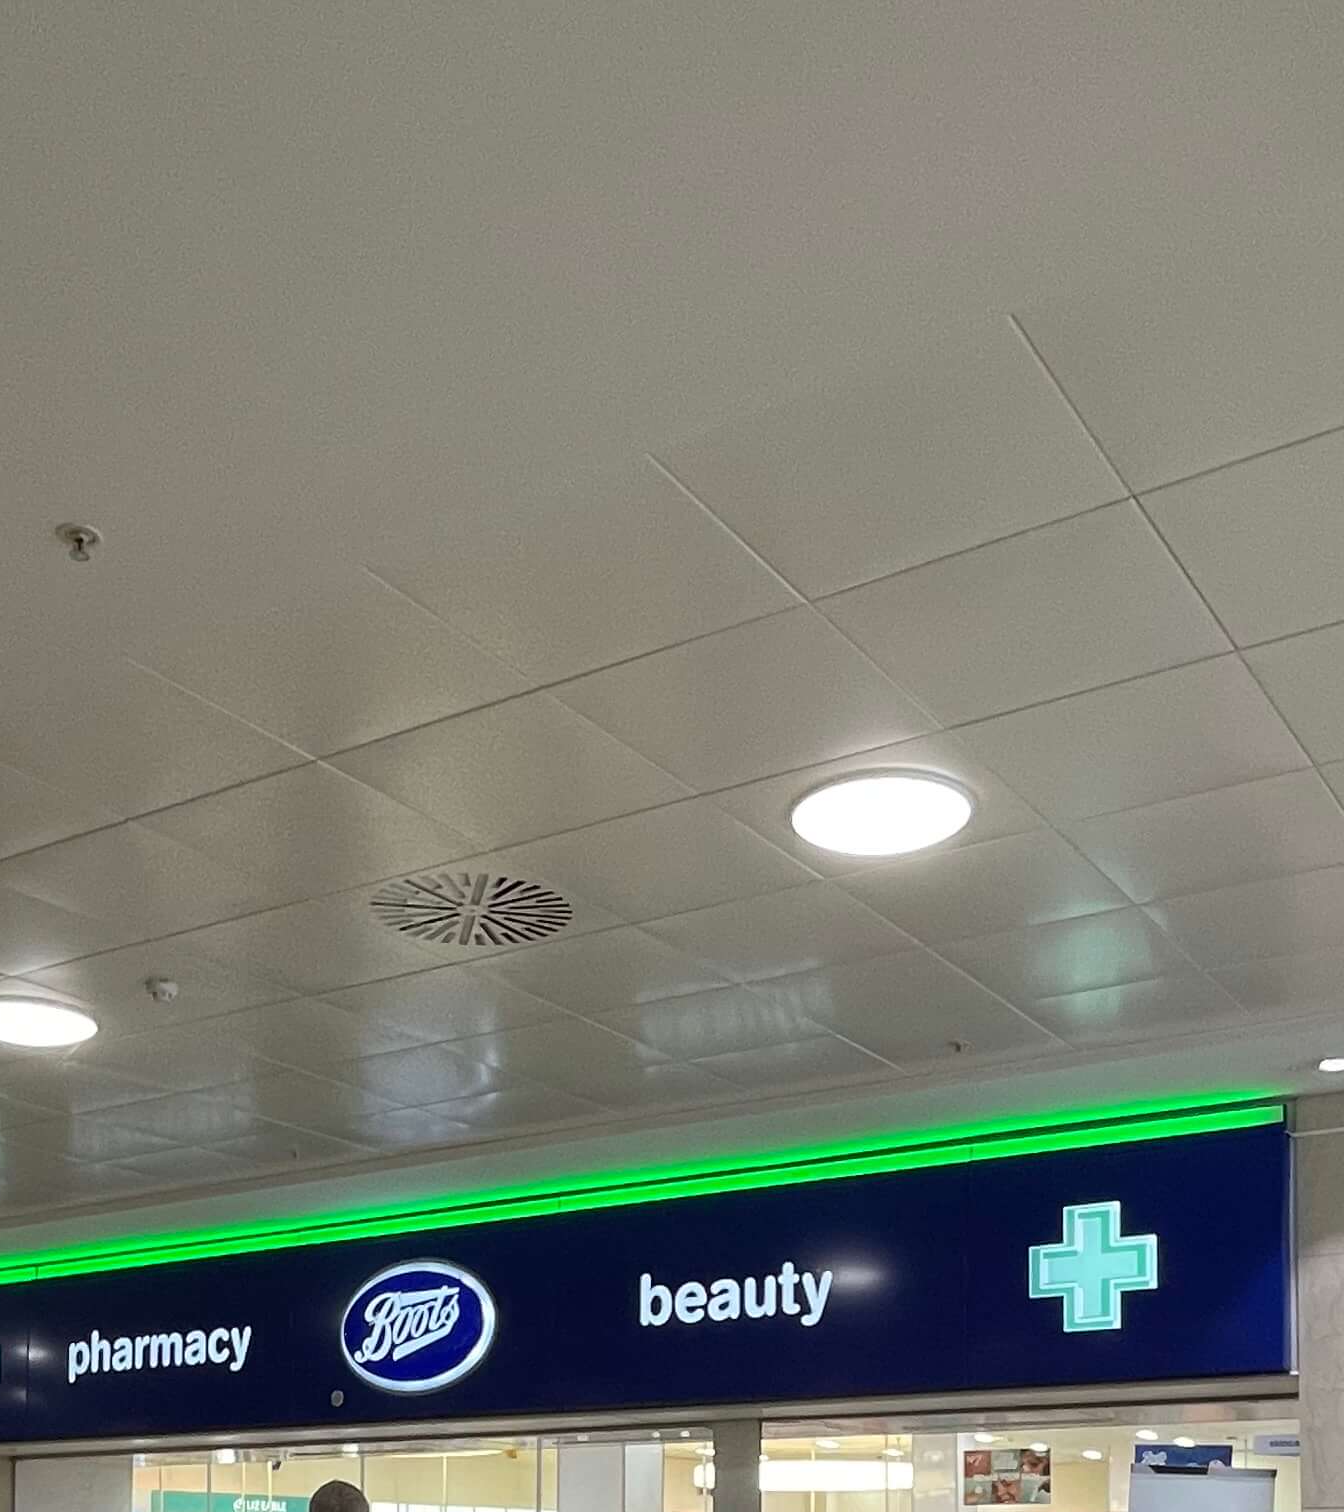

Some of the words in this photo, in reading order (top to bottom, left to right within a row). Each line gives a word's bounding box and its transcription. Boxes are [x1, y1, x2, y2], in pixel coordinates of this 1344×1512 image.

[355, 1286, 459, 1364] Boots
[640, 1262, 832, 1326] beauty
[68, 1326, 252, 1383] pharmacy
